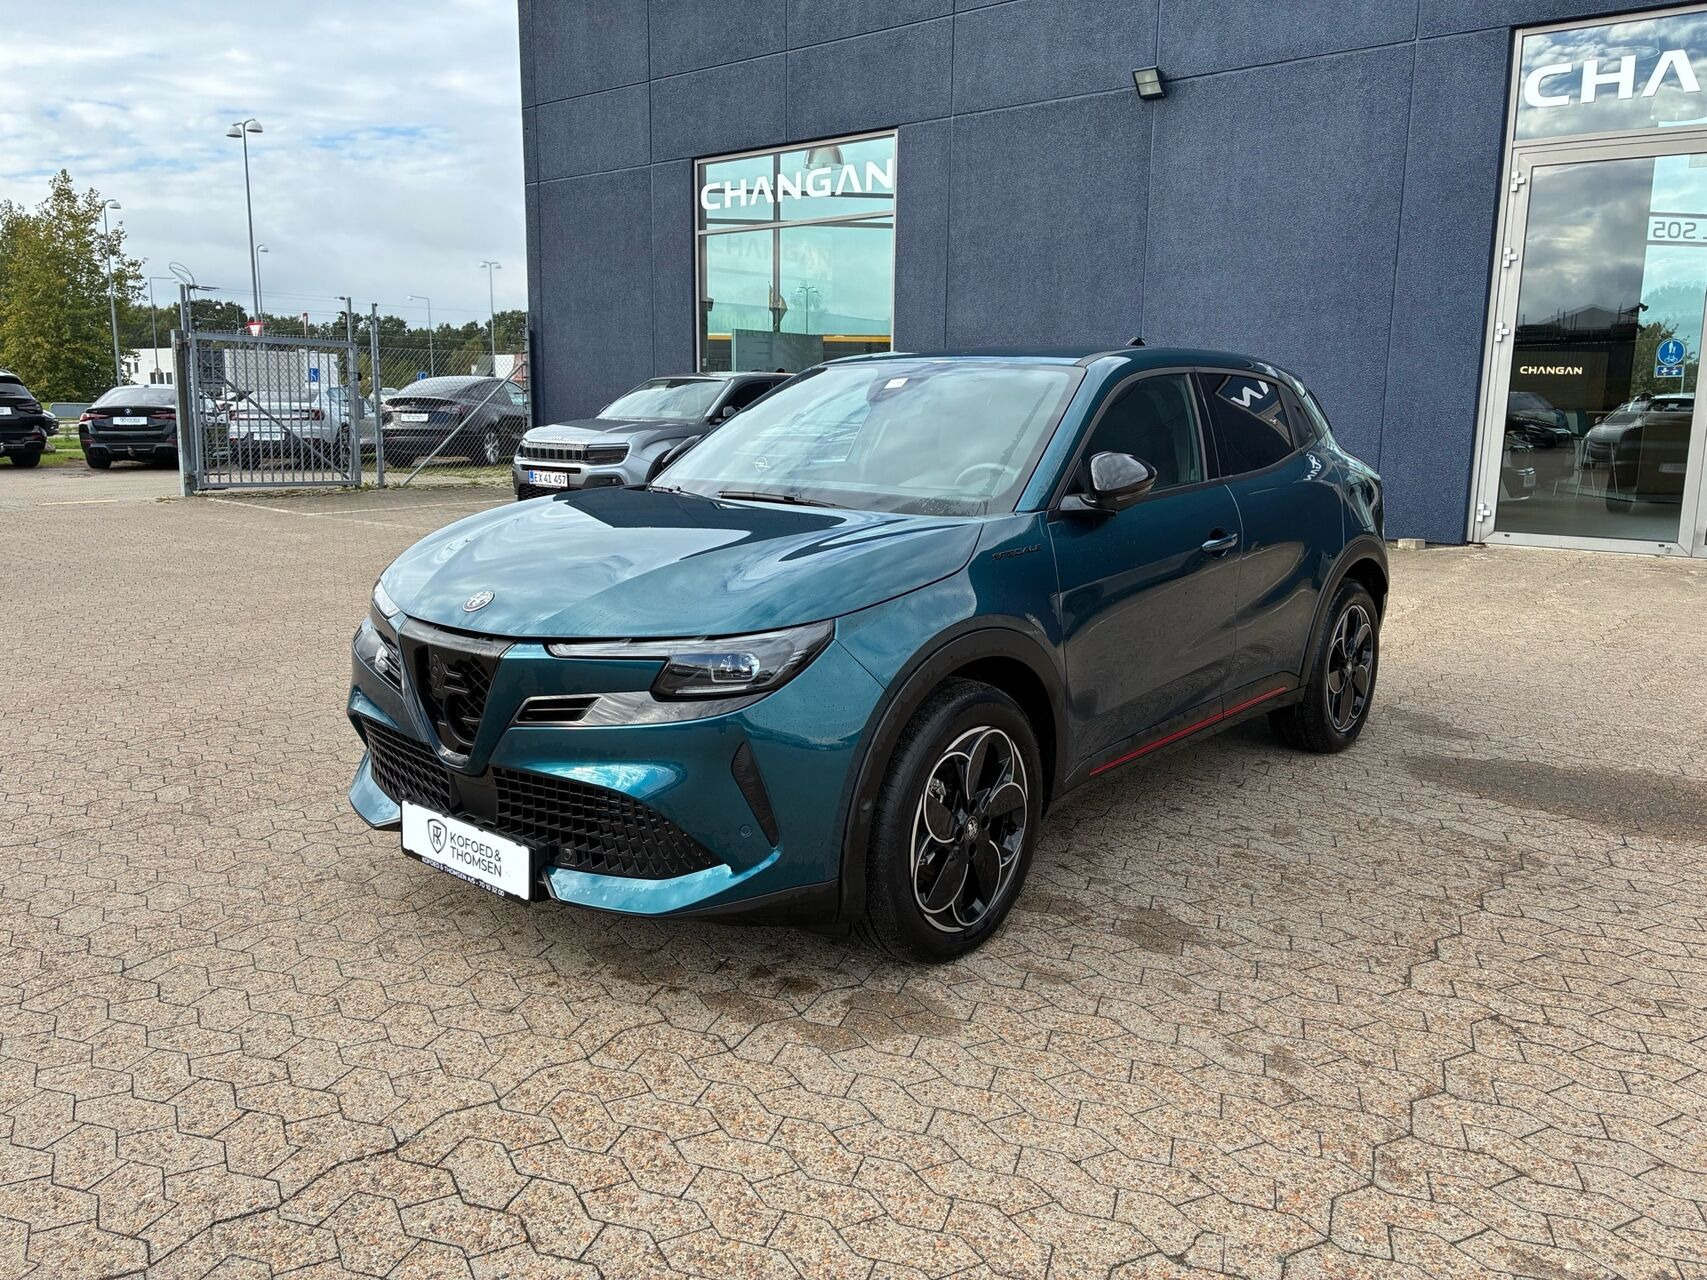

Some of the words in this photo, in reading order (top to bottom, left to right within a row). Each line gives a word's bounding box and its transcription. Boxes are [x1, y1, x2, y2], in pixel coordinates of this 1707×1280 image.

[1523, 49, 1701, 108] CHA
[701, 158, 893, 210] CHANGAN
[1519, 365, 1583, 375] CHANGAN
[534, 472, 543, 483] EX
[554, 474, 566, 485] 457
[450, 845, 502, 877] THOMSEN
